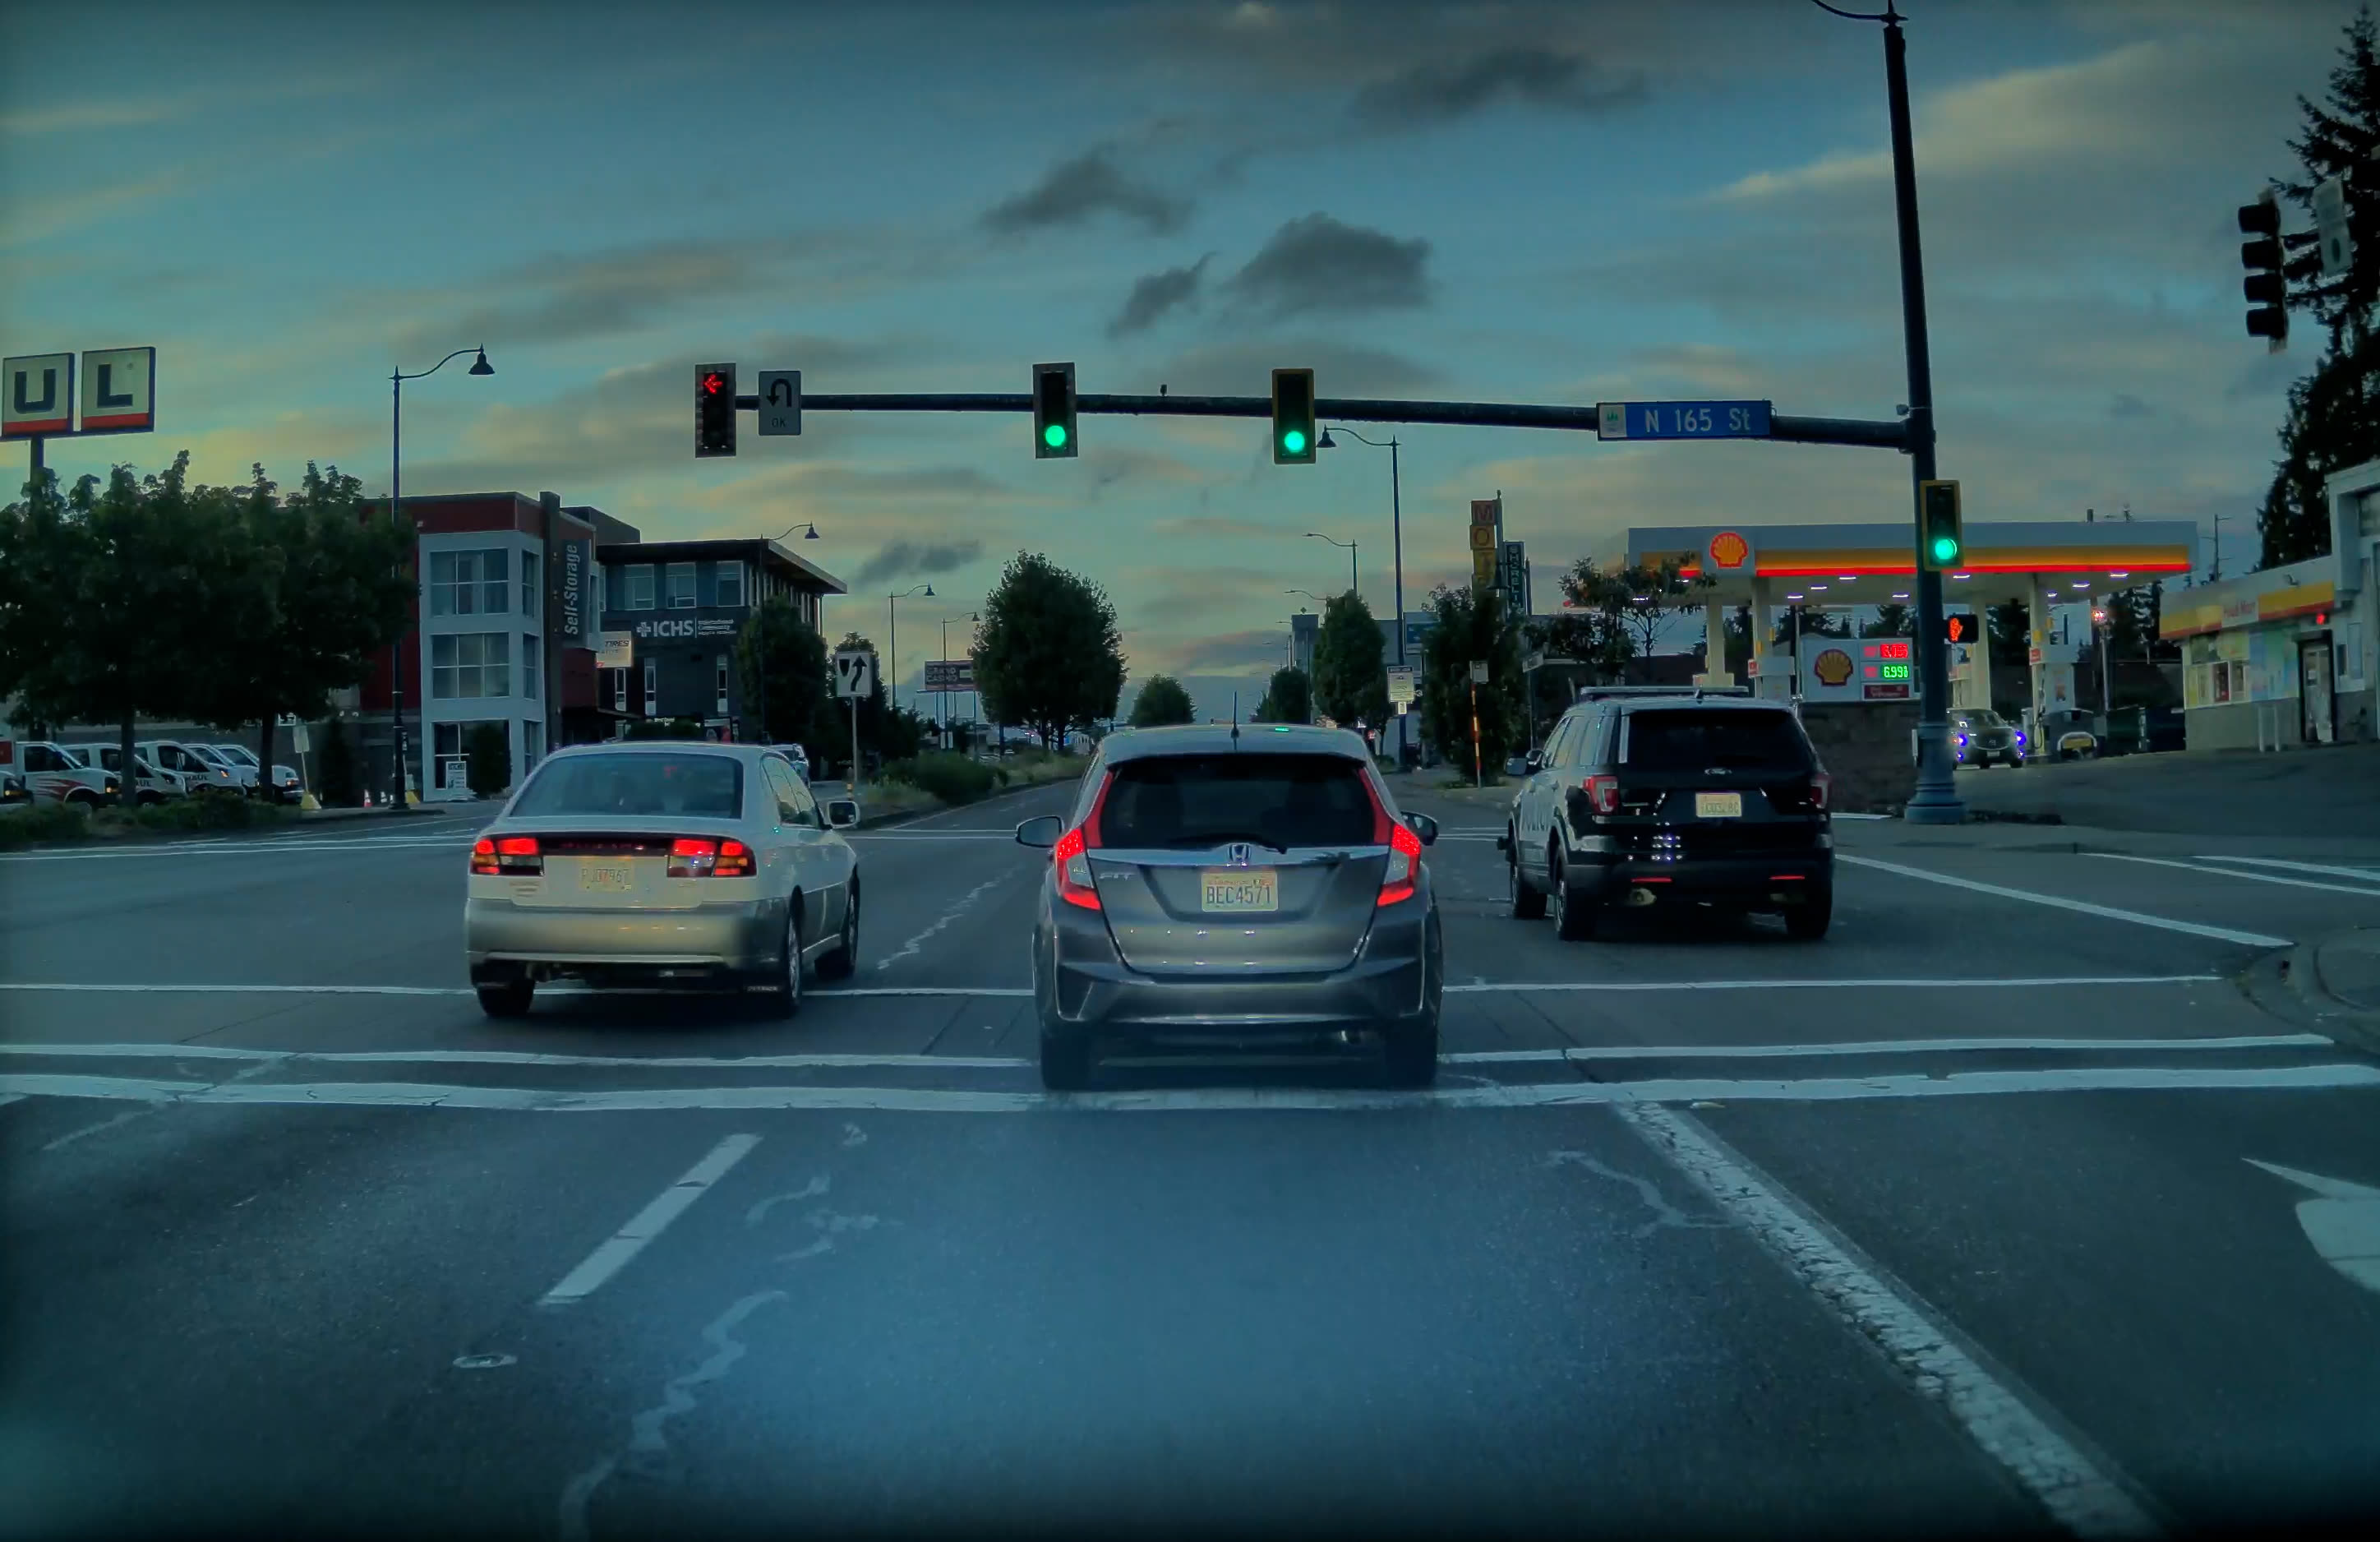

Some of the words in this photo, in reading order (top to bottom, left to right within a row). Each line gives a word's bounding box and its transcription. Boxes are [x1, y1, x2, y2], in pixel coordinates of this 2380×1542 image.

[1645, 409, 1659, 432] N
[1675, 409, 1712, 432] 165
[1728, 408, 1750, 431] St
[564, 544, 580, 635] Self-Storage
[653, 620, 694, 638] ICHS
[1206, 886, 1271, 904] BEC4571
